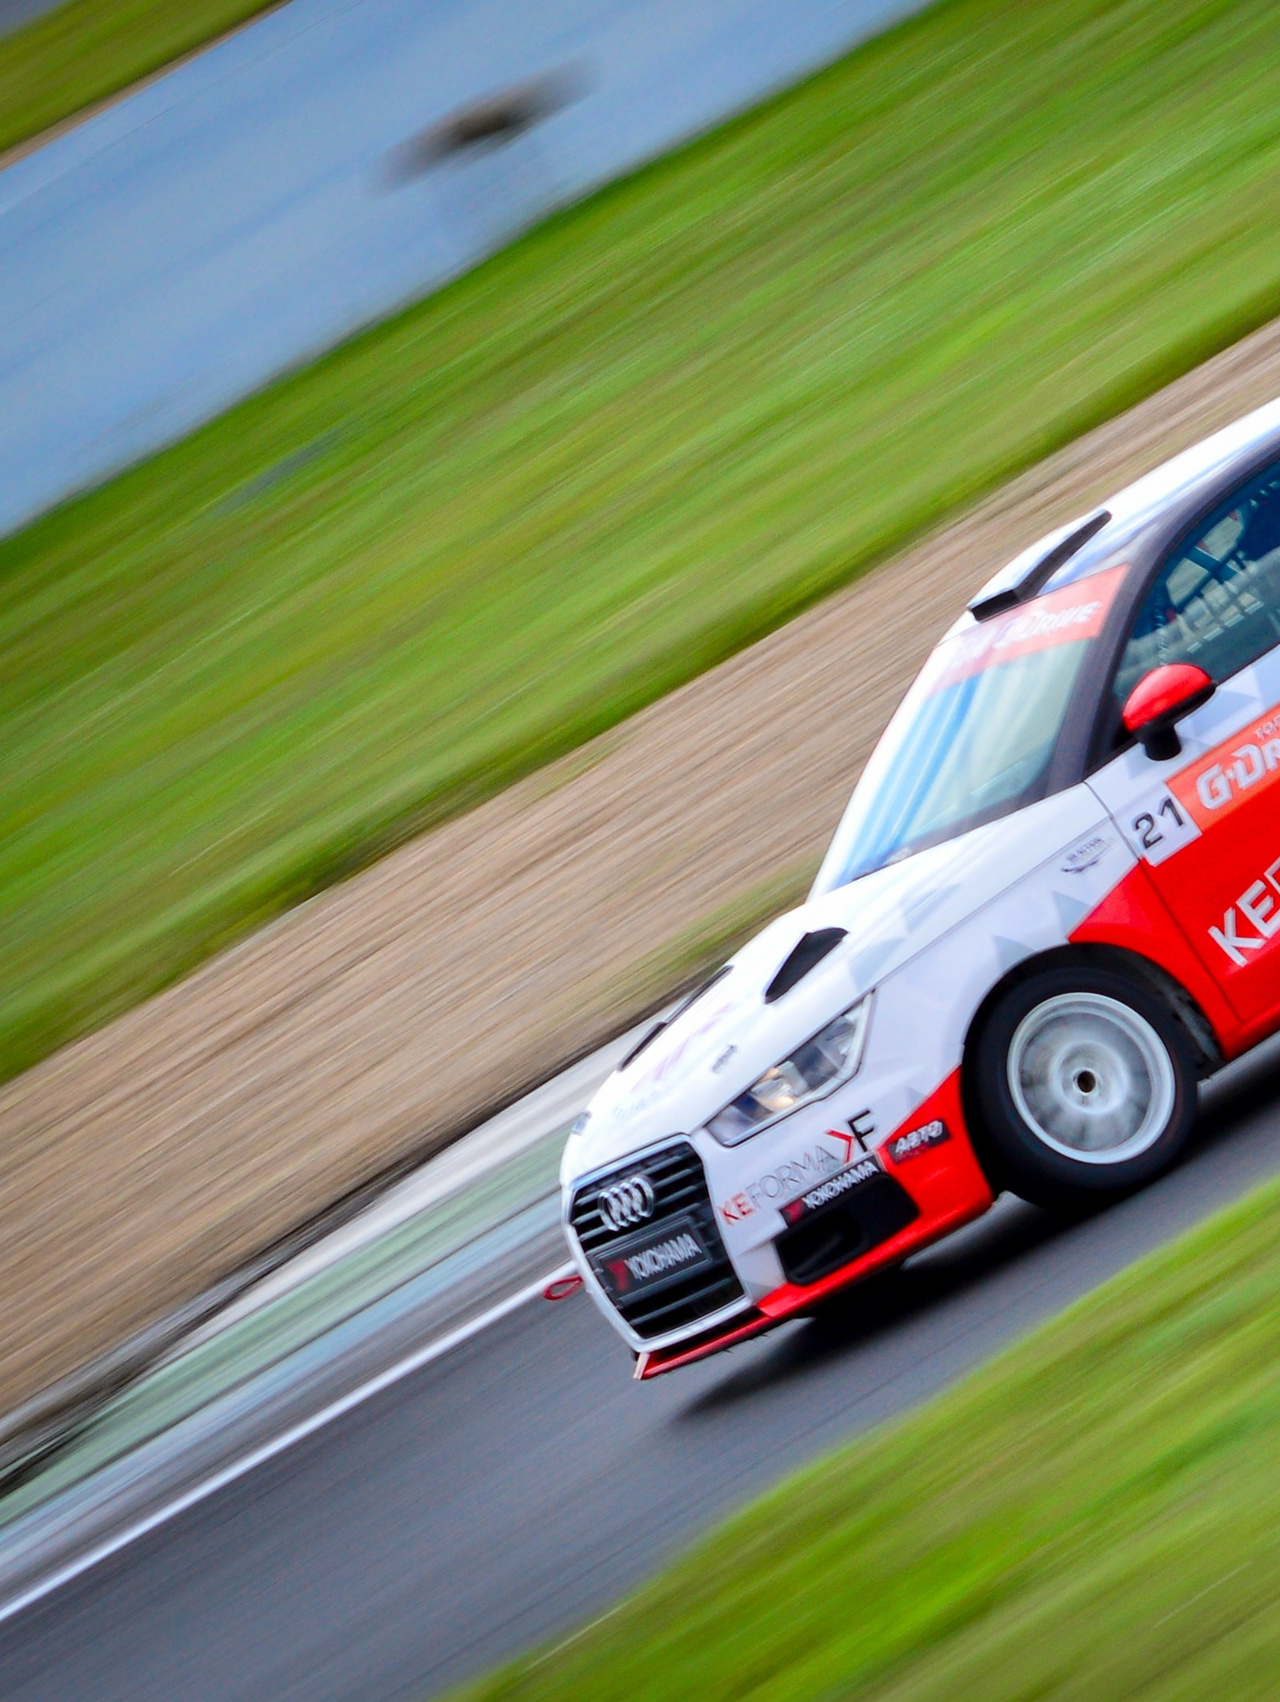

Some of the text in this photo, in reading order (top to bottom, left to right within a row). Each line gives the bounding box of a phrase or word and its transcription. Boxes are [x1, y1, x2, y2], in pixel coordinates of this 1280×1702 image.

[1133, 796, 1184, 850] 21
[718, 1145, 838, 1226] KEFORMA
[801, 1160, 879, 1210] YOKOHAMA
[624, 1233, 702, 1280] YOKOHAMA
